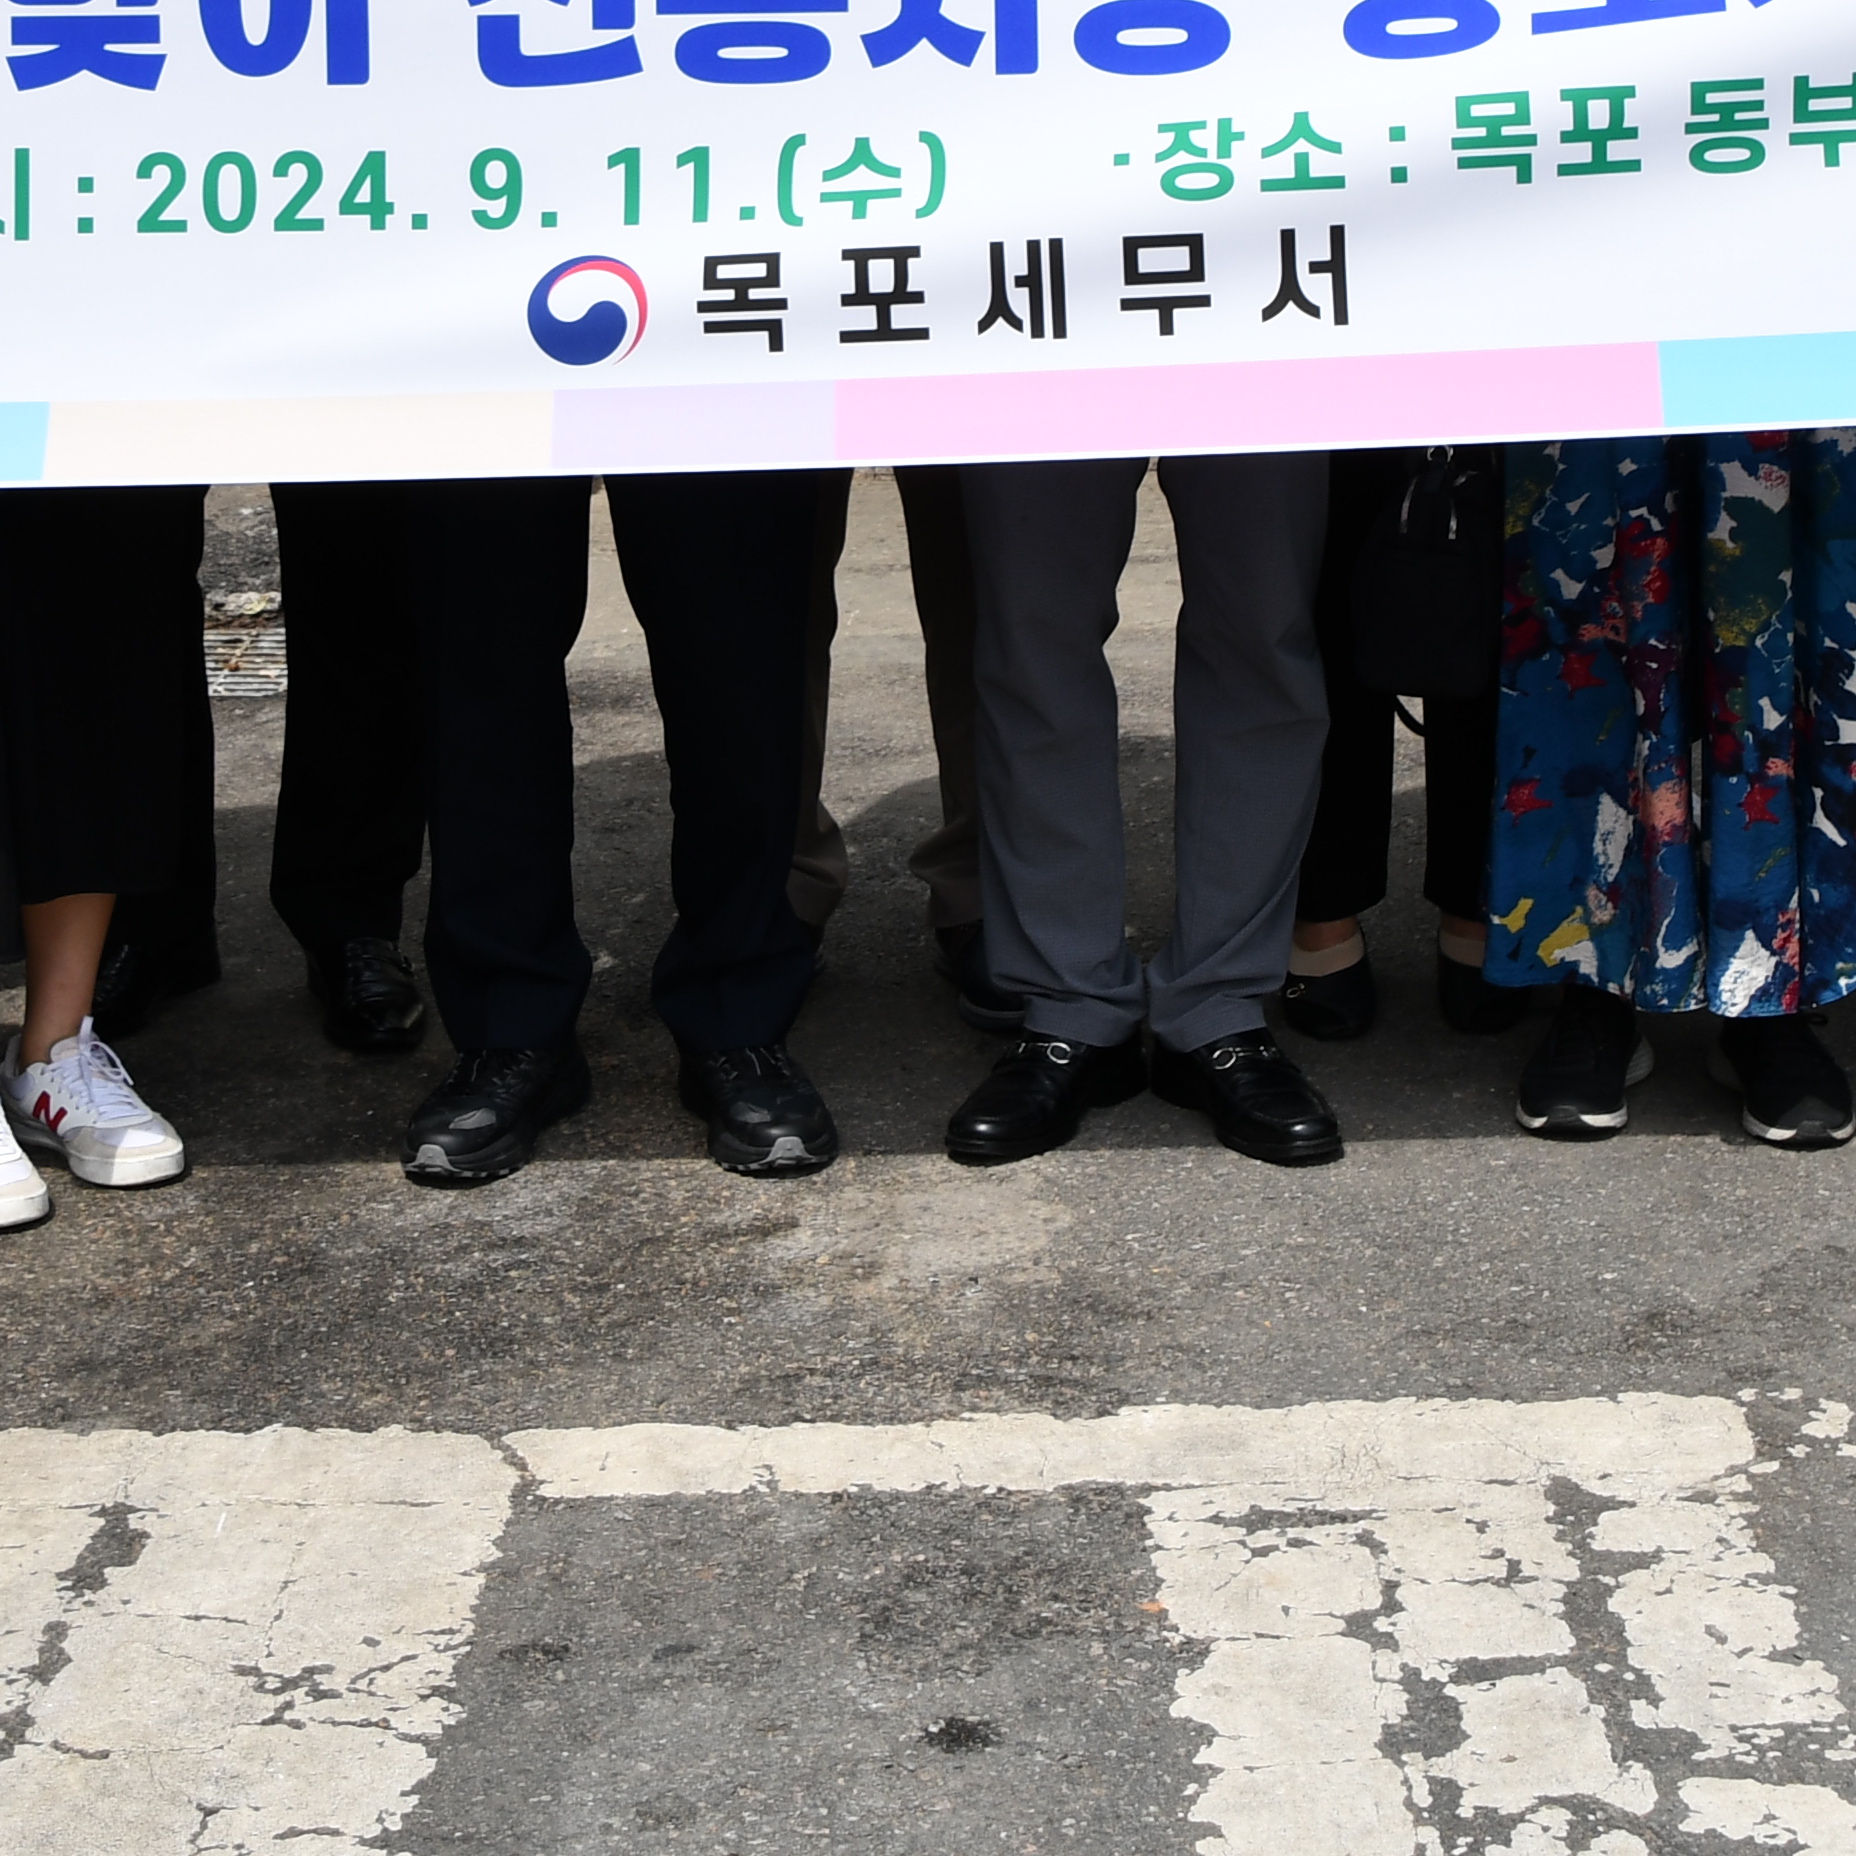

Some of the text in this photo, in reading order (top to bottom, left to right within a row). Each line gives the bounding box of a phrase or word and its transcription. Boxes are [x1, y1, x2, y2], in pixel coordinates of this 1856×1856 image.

[135, 151, 429, 235] 2024.
[467, 149, 558, 231] 9.
[605, 130, 948, 228] 11.(수)
[1449, 89, 1645, 186] 목포
